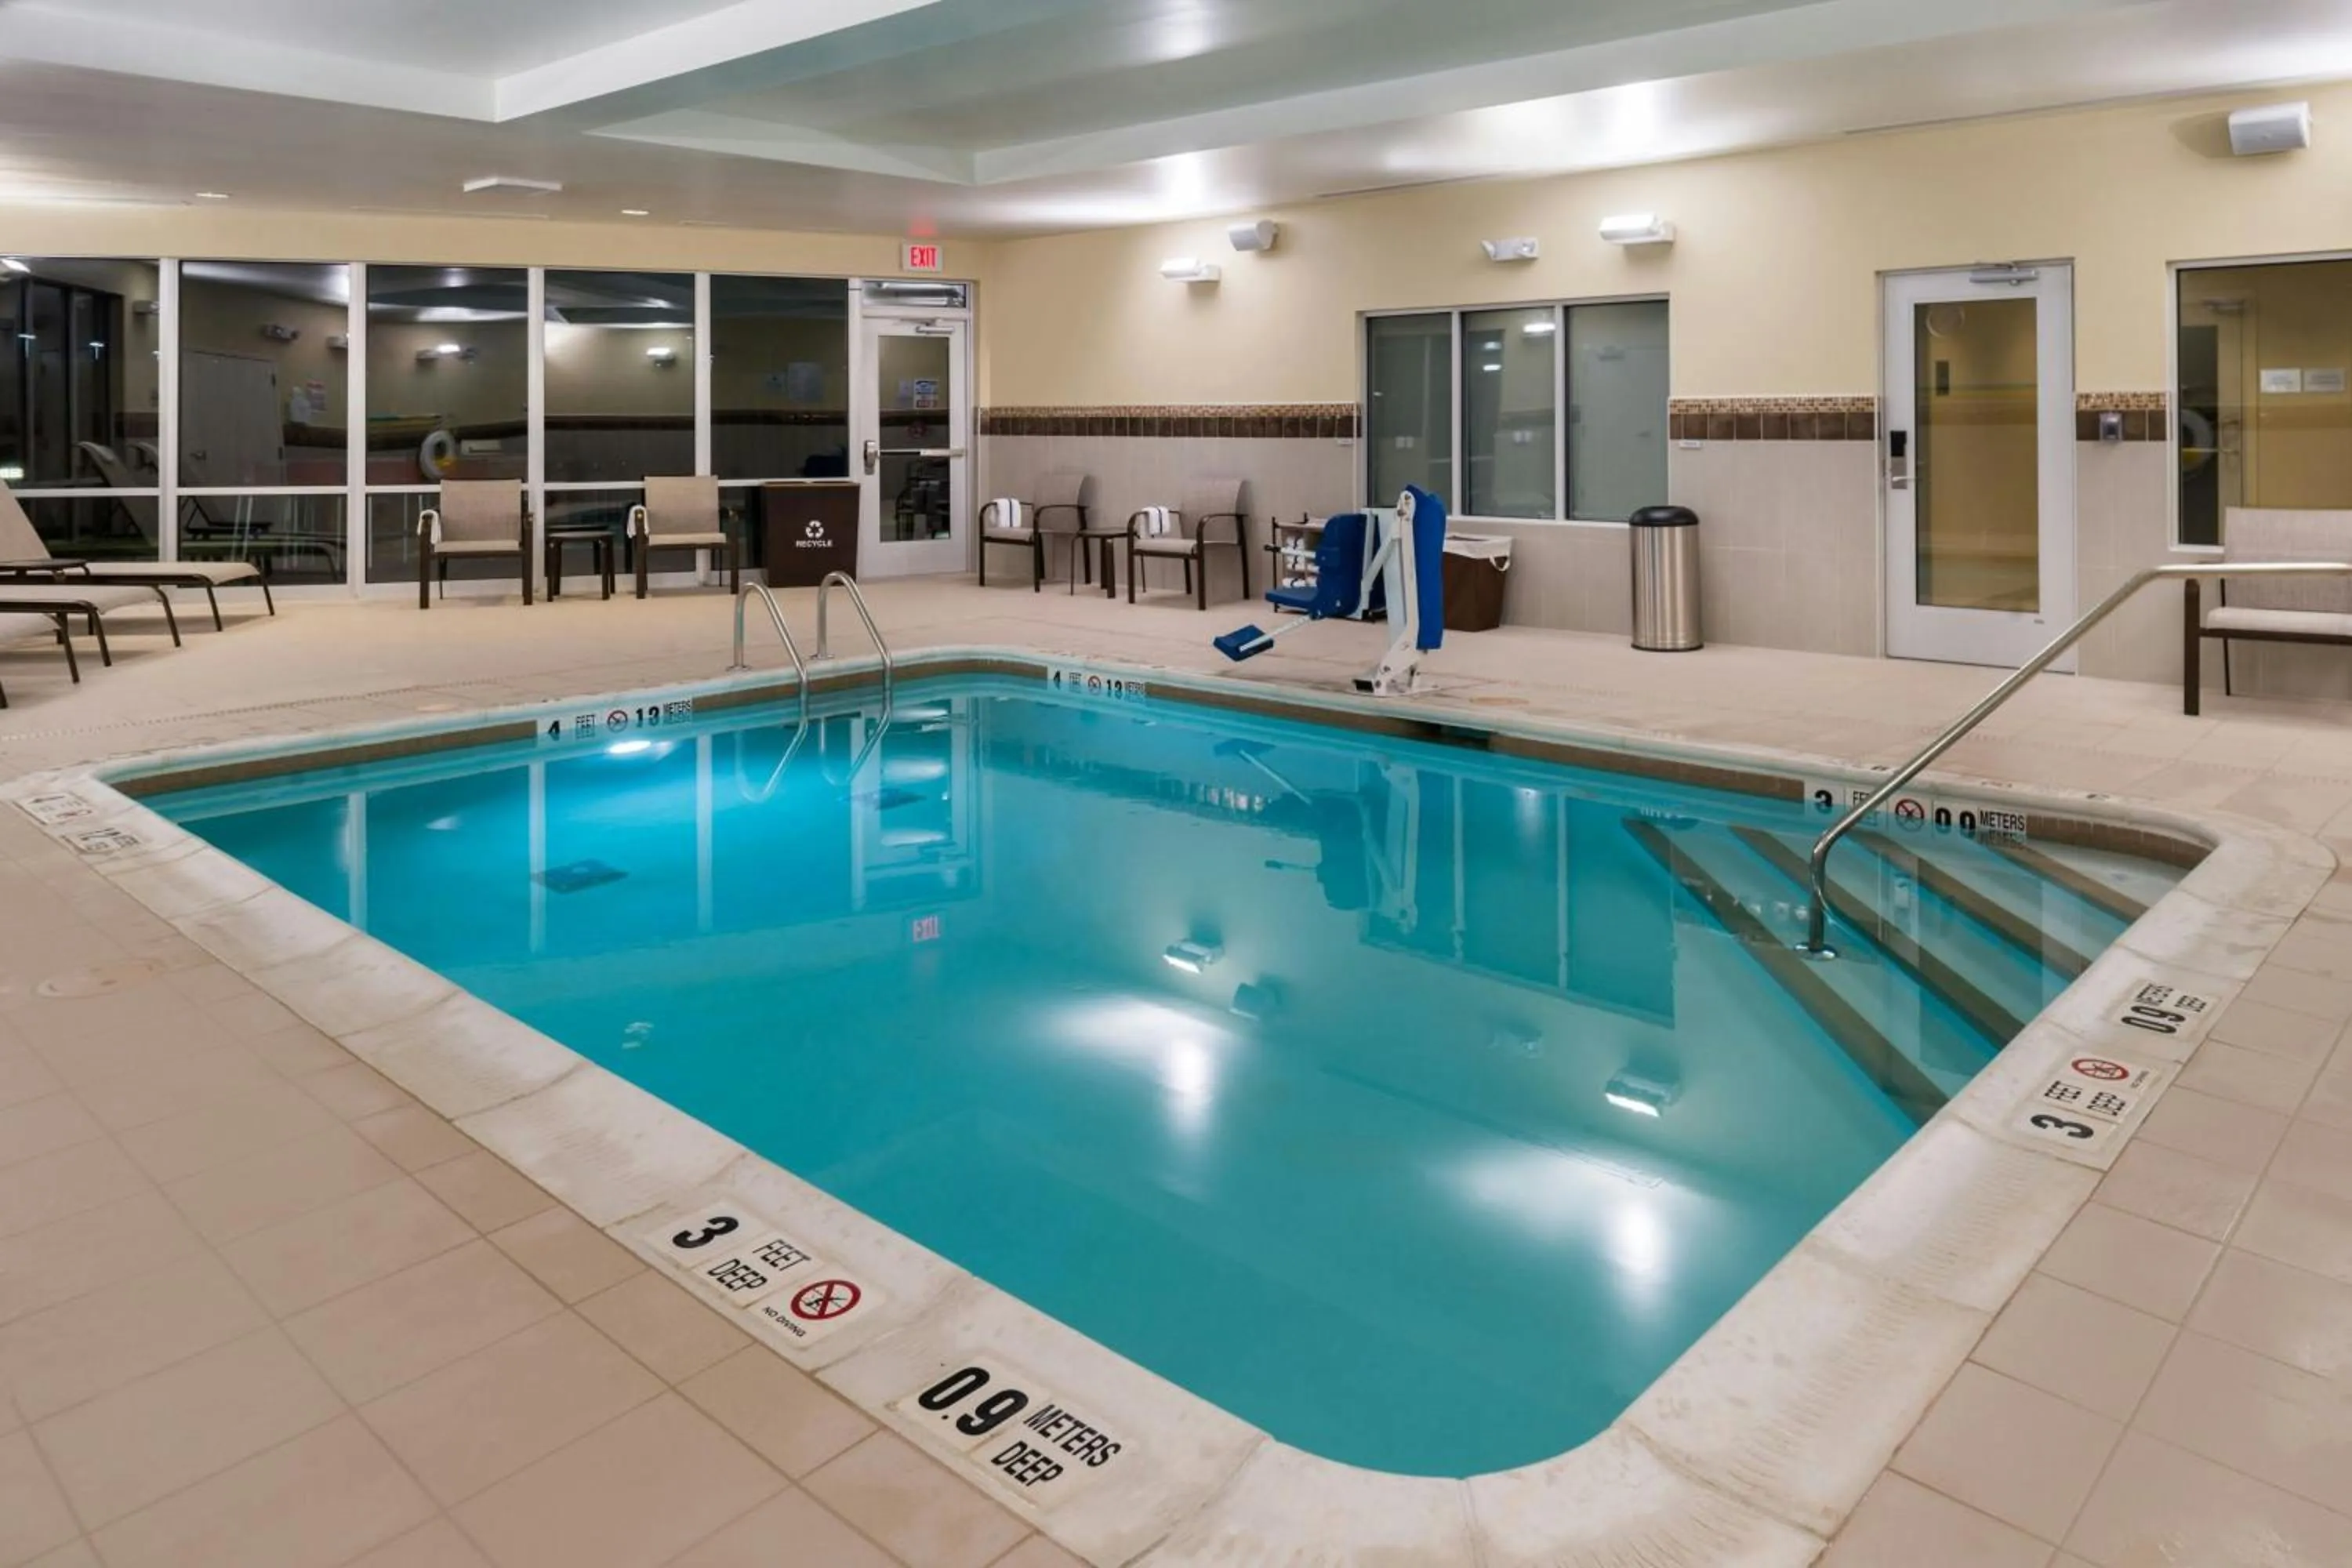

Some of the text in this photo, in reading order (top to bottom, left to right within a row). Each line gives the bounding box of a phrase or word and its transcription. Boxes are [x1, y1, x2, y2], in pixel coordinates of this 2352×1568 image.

[910, 246, 937, 267] EXIT
[796, 539, 833, 548] RECYCLE
[1980, 809, 2025, 831] METERS
[2030, 1113, 2094, 1140] 3
[671, 1215, 812, 1272] 3 FEET
[707, 1258, 768, 1292] DEEP
[761, 1305, 806, 1338] NO DIVING
[918, 1366, 1122, 1468] 0.9 METERS
[990, 1440, 1064, 1486] DEEP
